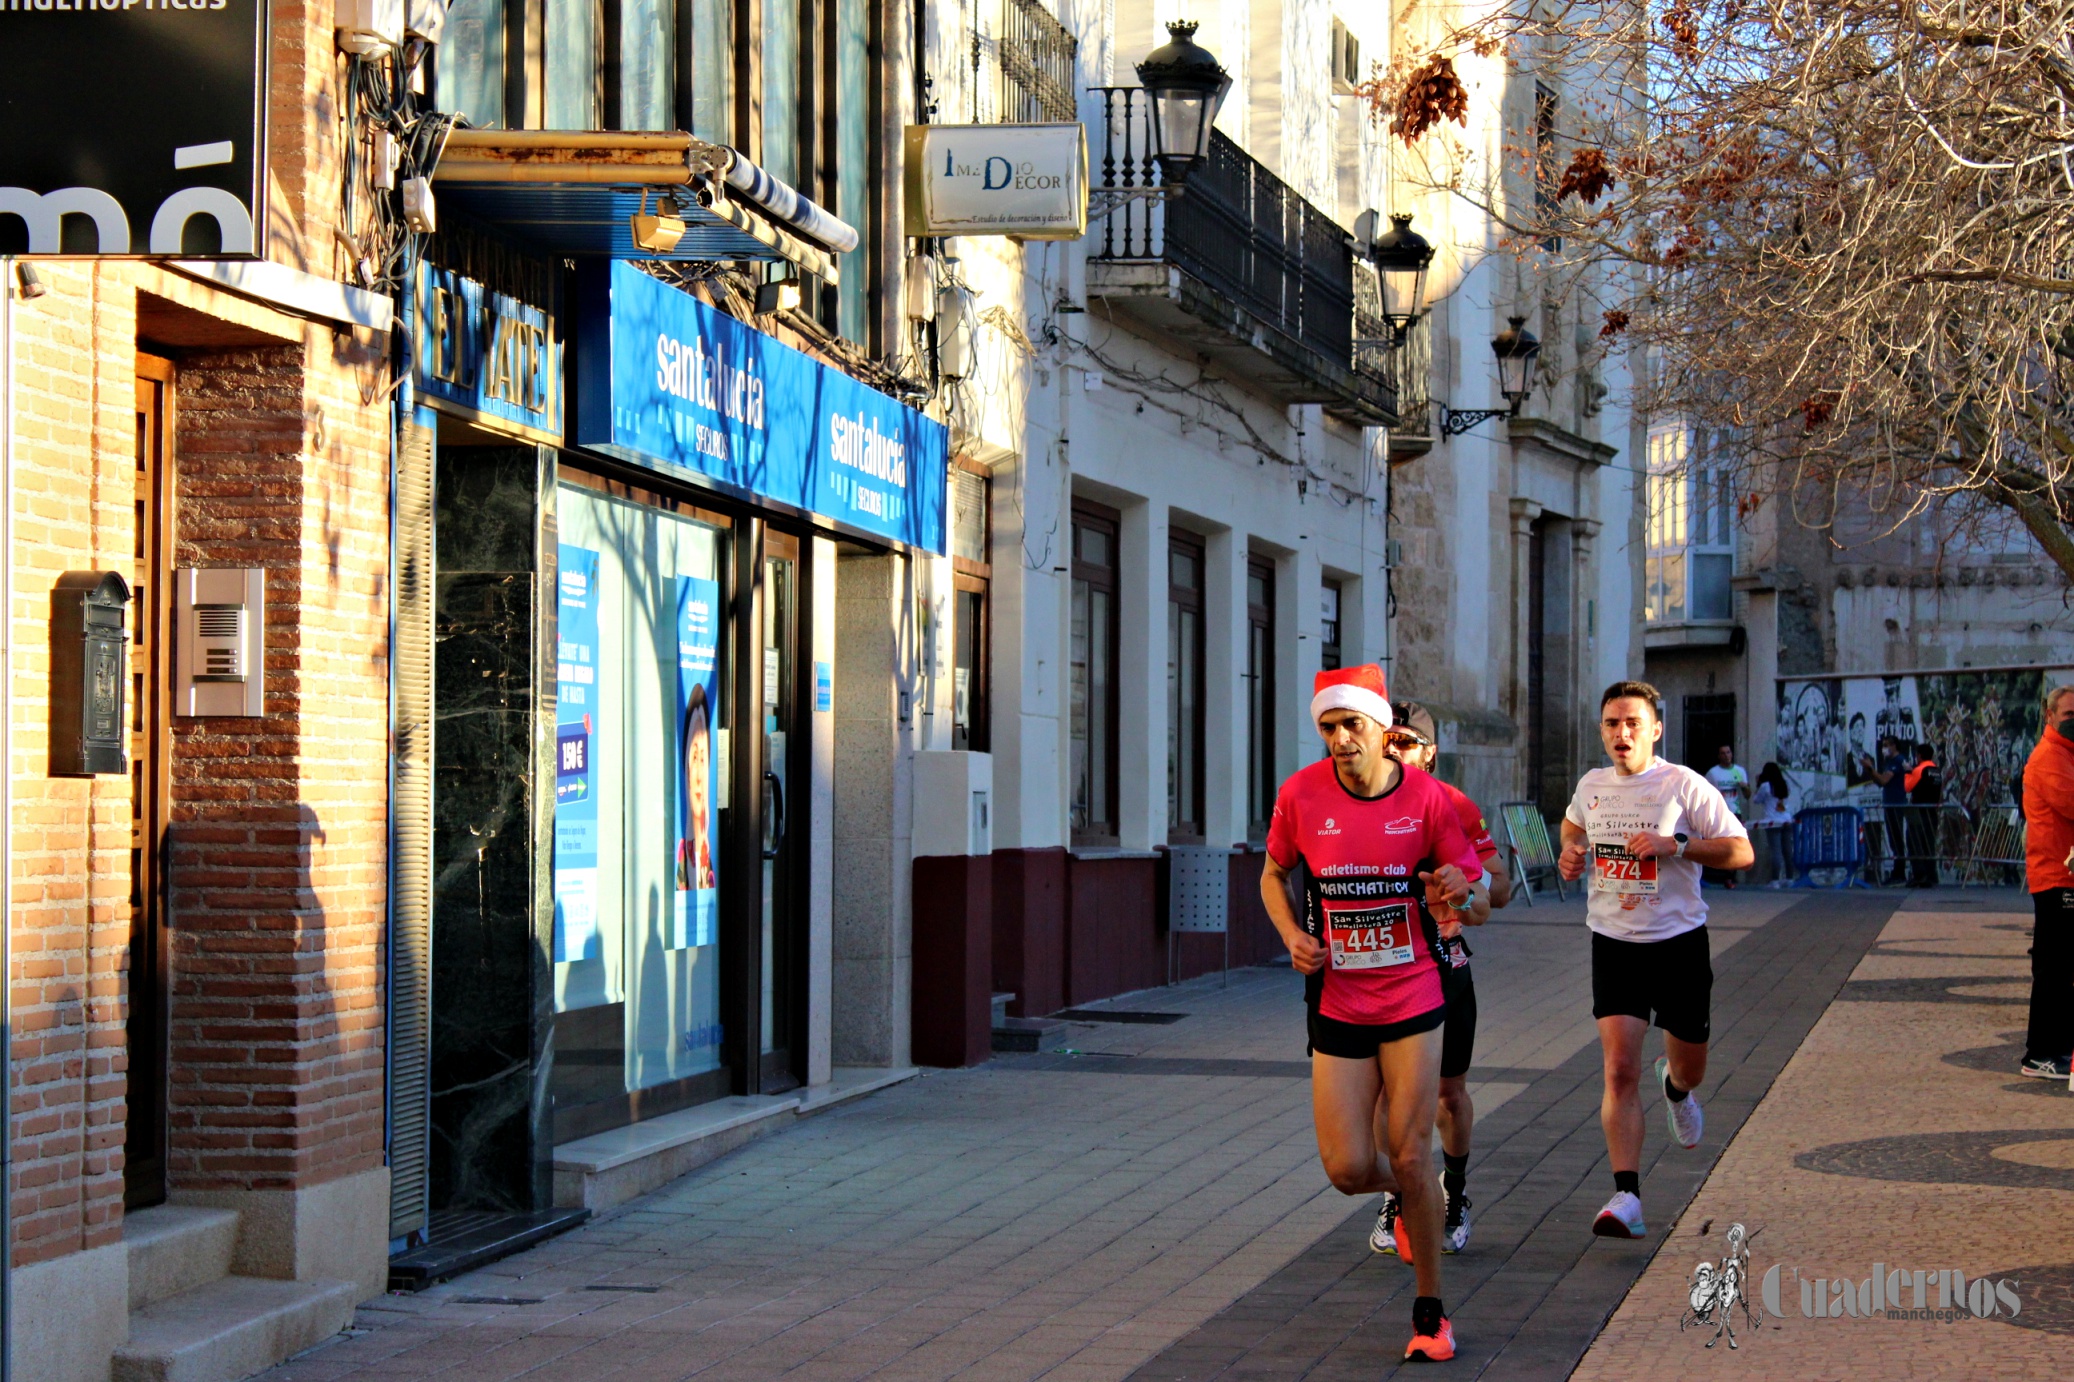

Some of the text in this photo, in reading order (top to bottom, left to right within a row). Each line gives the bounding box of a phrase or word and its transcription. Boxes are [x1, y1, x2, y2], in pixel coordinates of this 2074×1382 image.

[999, 214, 1006, 222] de
[432, 287, 545, 413] EL YATE
[657, 333, 763, 430] santalucía
[696, 423, 728, 461] SEGUROS
[831, 411, 905, 488] santalucía
[857, 485, 882, 517] SEGUROS
[1606, 820, 1659, 830] Silvestre
[1321, 863, 1406, 876] atletismo club
[1606, 860, 1641, 879] 274
[1347, 926, 1394, 952] 445
